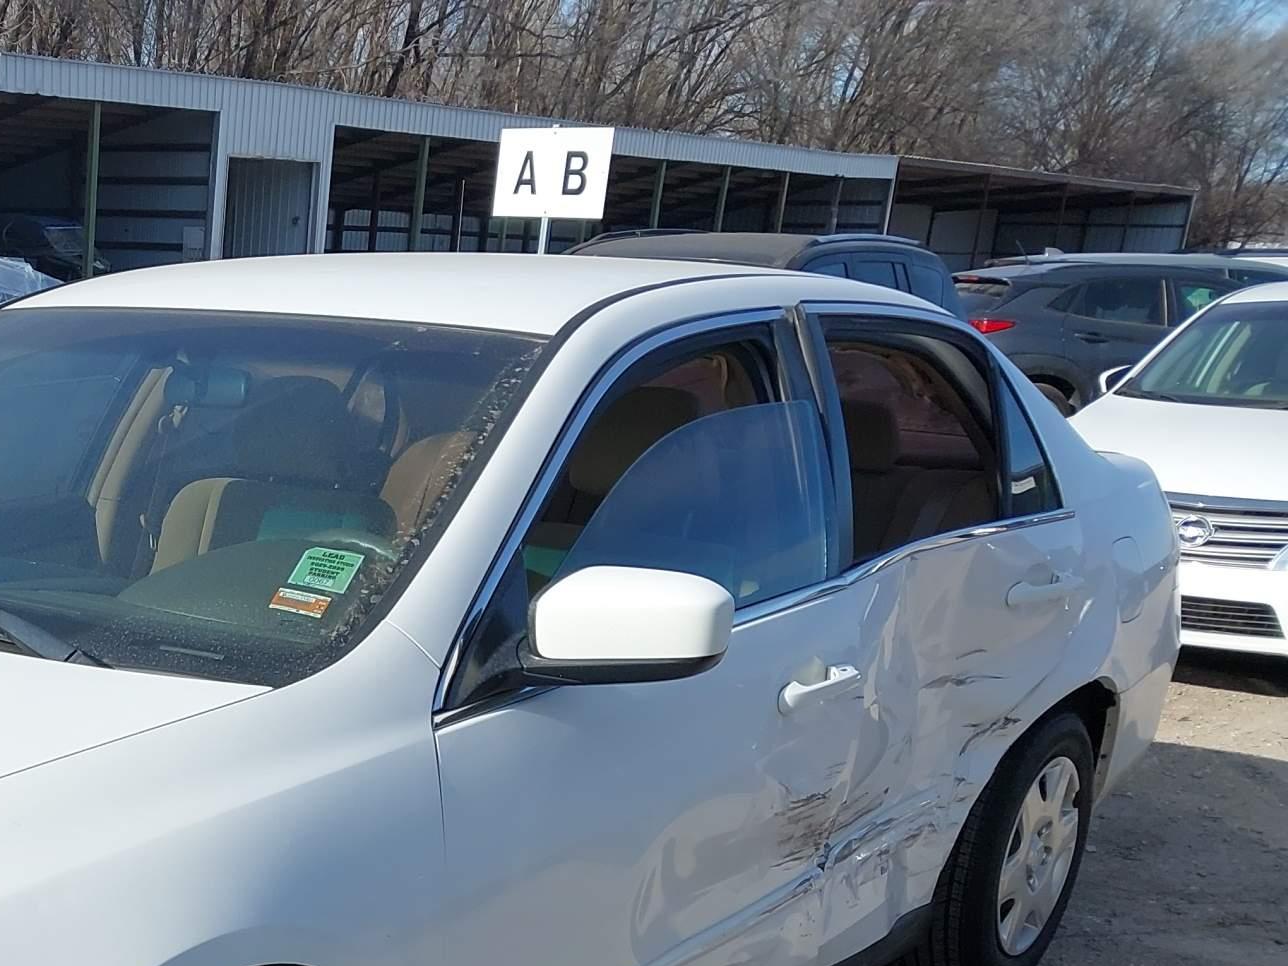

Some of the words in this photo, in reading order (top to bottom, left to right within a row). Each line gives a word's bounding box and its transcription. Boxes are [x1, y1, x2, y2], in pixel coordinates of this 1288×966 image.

[513, 151, 537, 195] A
[562, 151, 589, 196] B
[322, 552, 345, 561] LEAD
